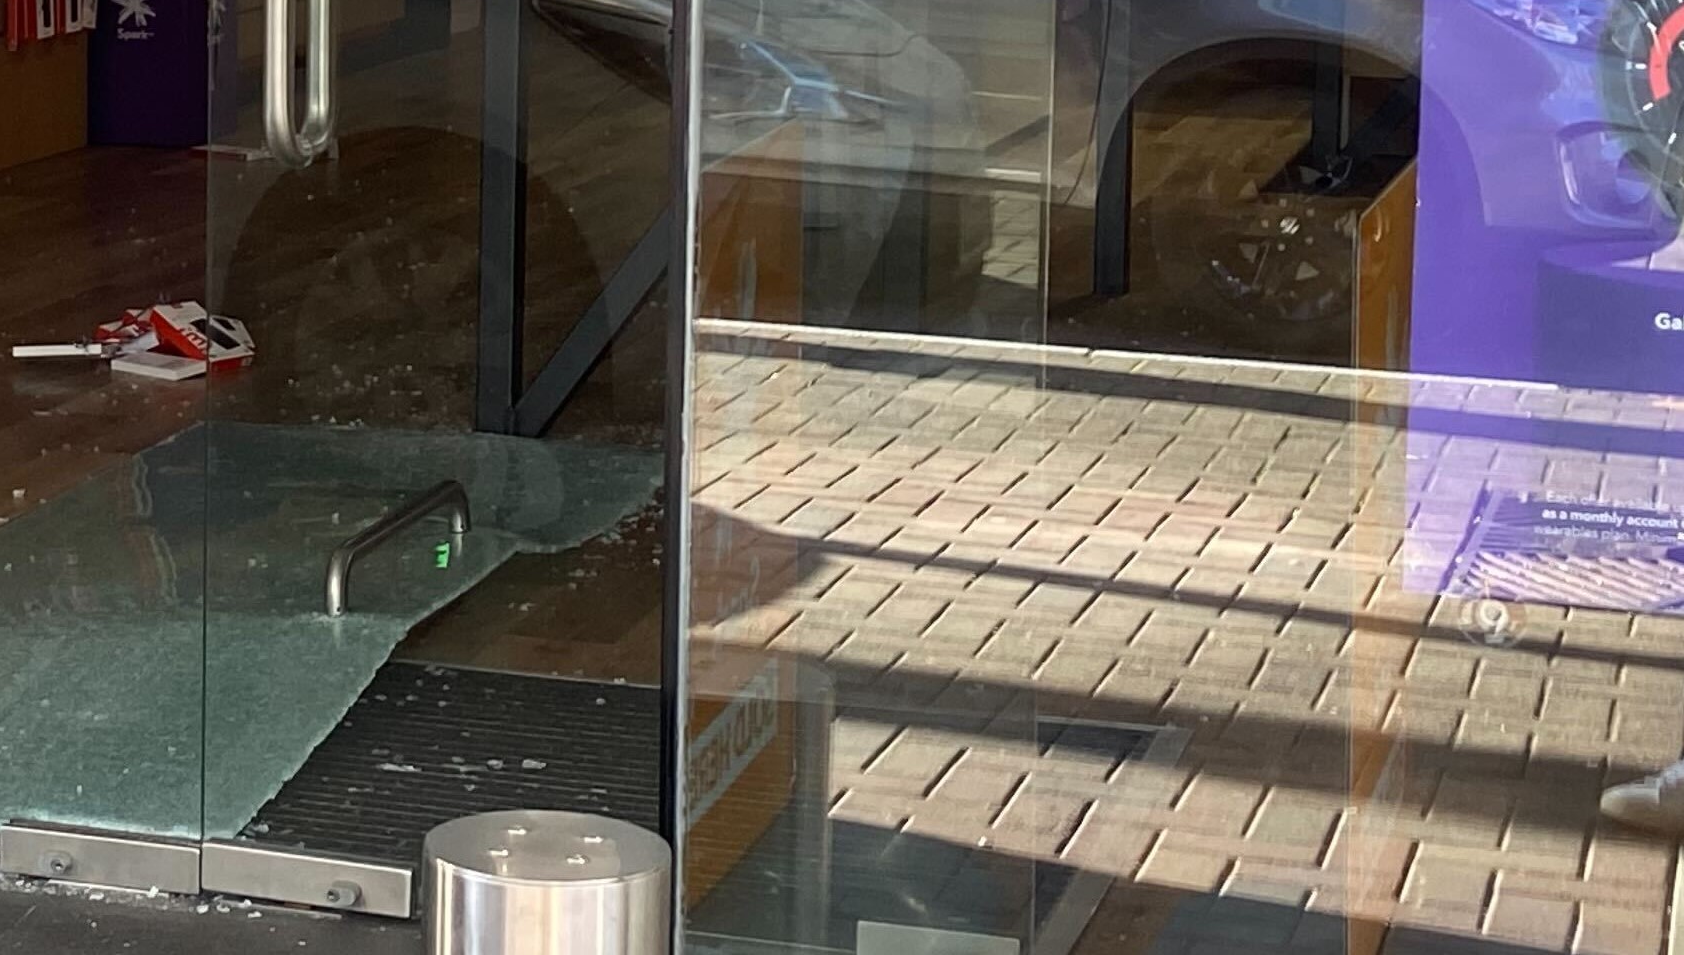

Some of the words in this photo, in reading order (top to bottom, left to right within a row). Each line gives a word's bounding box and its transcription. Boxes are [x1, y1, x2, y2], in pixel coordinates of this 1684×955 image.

[1542, 509, 1557, 520] as
[1559, 510, 1567, 520] a
[1570, 510, 1624, 528] monthly
[1626, 515, 1679, 529] account
